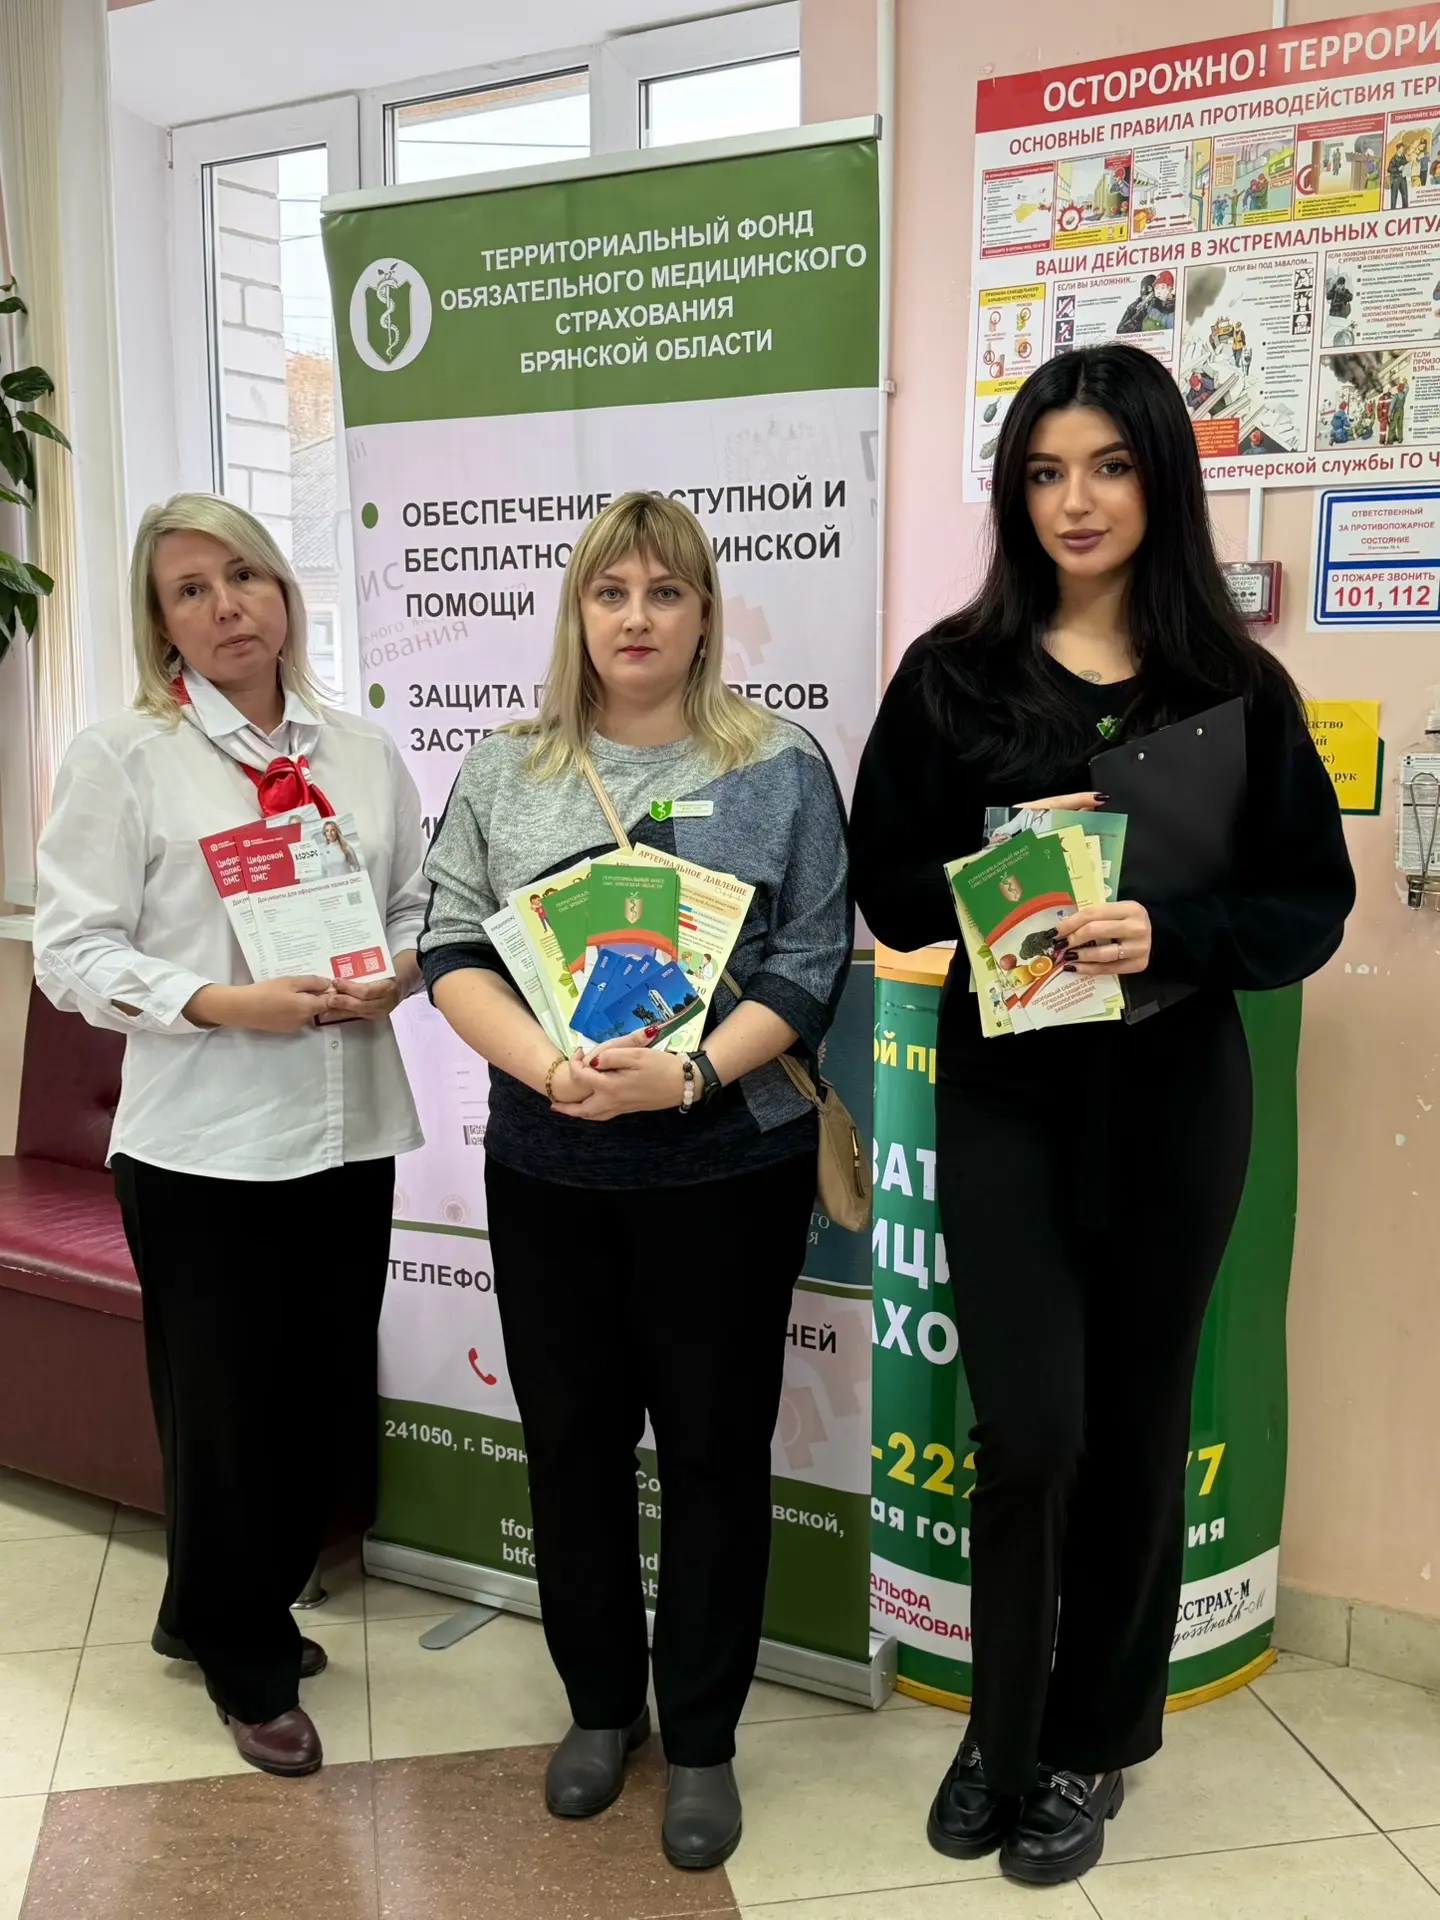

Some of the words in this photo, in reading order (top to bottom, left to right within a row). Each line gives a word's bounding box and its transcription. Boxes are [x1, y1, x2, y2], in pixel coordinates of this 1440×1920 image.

[1043, 45, 1267, 113] ОСТОРОЖНО!
[1278, 18, 1440, 73] ТЕРРОРИ
[1009, 125, 1105, 156] ОСНОВНЫЕ
[1110, 112, 1194, 140] ПРАВИЛА
[1200, 81, 1395, 126] ПРОТИВОДЕЙСТВИЯ
[1401, 76, 1440, 98] ТЕР
[482, 216, 729, 272] ТЕРРИТОРИАЛЬНЫЙ
[737, 209, 813, 241] ФОНД
[1036, 249, 1088, 276] ВАШИ
[1091, 240, 1185, 274] ДЕЙСТВИЯ
[1190, 240, 1201, 257] В
[1207, 220, 1379, 257] ЭКСТРЕМАЛЬНЫХ
[440, 268, 644, 311] ОБЯЗАТЕЛЬНОГО
[650, 243, 867, 288] МЕДИЦИНСКОГО
[1229, 265, 1246, 273] ЕСЛИ
[1258, 262, 1273, 271] ПОД
[1057, 283, 1075, 292] ЕСЛИ
[1078, 282, 1088, 290] ВЫ
[555, 296, 733, 335] СТРАХОВАНИЯ
[520, 336, 648, 374] БРЯНСКОЙ
[655, 328, 773, 363] ОБЛАСТИ
[1322, 453, 1394, 476] службы
[1400, 452, 1423, 469] ГО
[403, 493, 612, 527] ОБЕСПЕЧЕНИЕ
[648, 474, 812, 515] ТУПНОЙ
[824, 480, 846, 507] И
[1351, 507, 1423, 518] ОТВЕТСТВЕННЫЙ
[1338, 524, 1349, 532] ЗА
[1351, 521, 1435, 532] ПРОТИВОПОЖАРНОЕ
[1361, 536, 1410, 545] СОСТОЯНИЕ
[1331, 574, 1340, 583] О
[1342, 573, 1385, 583] ПОЖАРЕ
[1387, 572, 1435, 582] ЗВОНИТЬ
[406, 591, 534, 621] ПОМОЩИ
[1334, 586, 1383, 610] 101,
[1388, 585, 1431, 606] 112
[408, 684, 526, 712] ЗАЩИТА
[410, 728, 494, 752] ЗАСТ
[1334, 772, 1358, 783] рук
[246, 850, 284, 864] Цифровой
[248, 863, 272, 874] полис
[222, 875, 241, 887] ОМС
[251, 873, 269, 883] ОМС
[637, 849, 702, 880] АРТЕРИАЛЬНОЕ
[702, 872, 748, 898] ДАВЛЕНИЕ
[388, 1259, 497, 1294] ТЕЛЕФО
[872, 1298, 959, 1365] ХО
[385, 1420, 457, 1451] 241050,
[463, 1436, 475, 1451] г.
[772, 1504, 844, 1538] вской,
[870, 1573, 932, 1612] АЛЬФА
